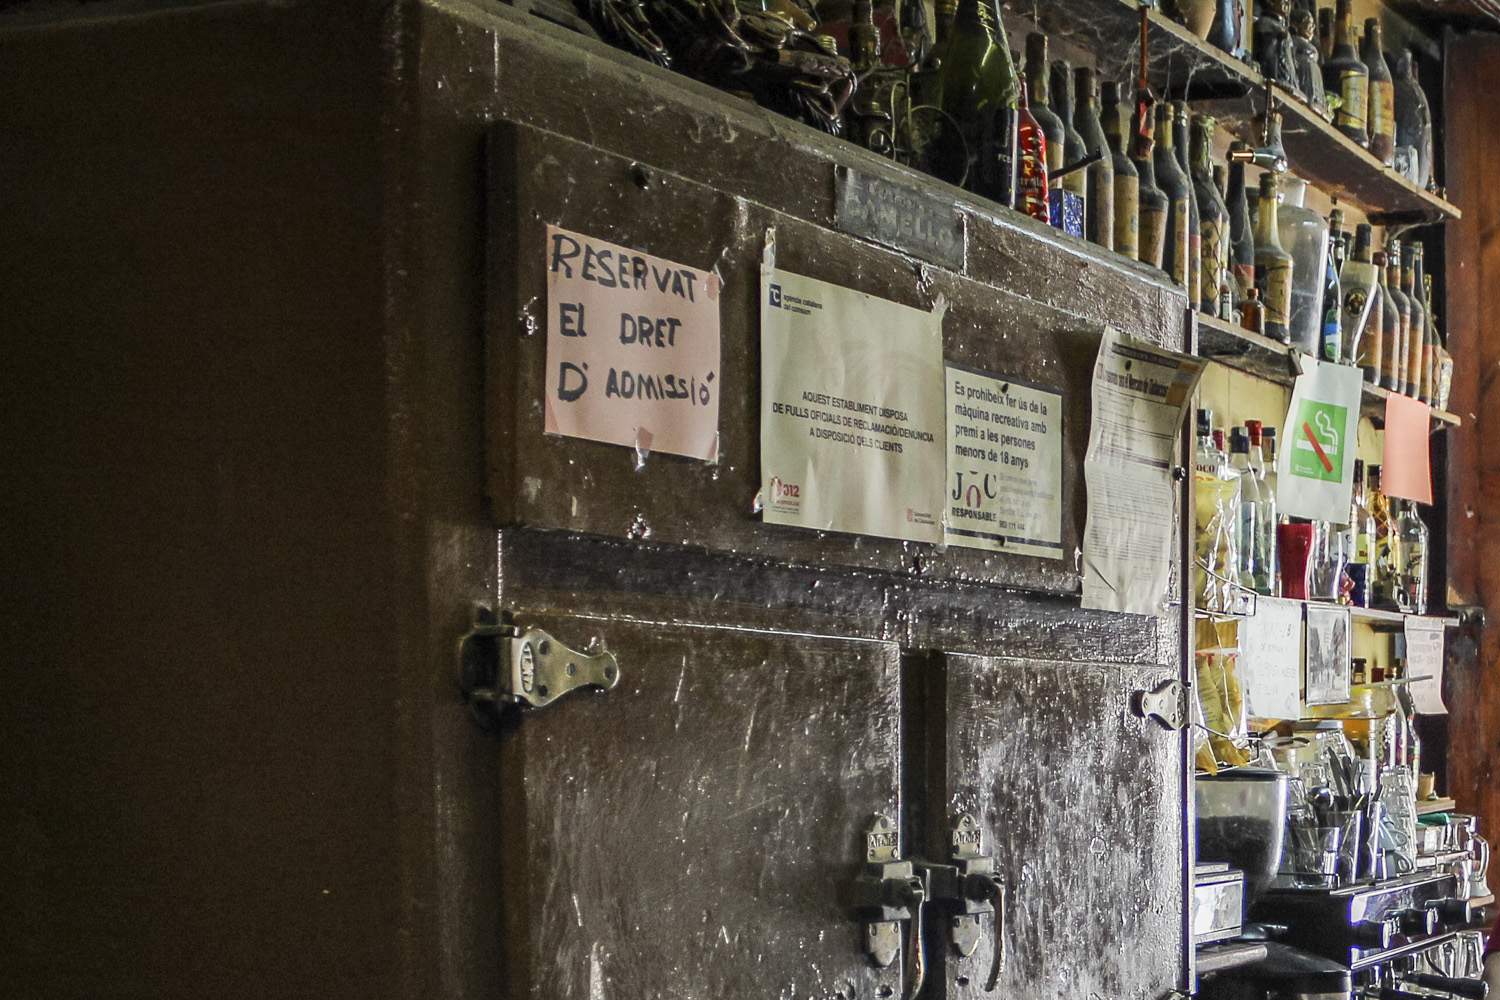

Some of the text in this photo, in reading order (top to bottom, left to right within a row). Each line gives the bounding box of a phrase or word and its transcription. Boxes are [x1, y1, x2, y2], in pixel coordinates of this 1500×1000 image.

[551, 234, 697, 303] RESERVAT
[619, 312, 682, 348] DRET
[802, 391, 908, 421] AQUEST ESTABLIMENT DISPOSA
[955, 381, 1048, 416] Es prohibeix fer ús de la
[772, 402, 783, 414] DE
[785, 404, 809, 419] FULLS
[810, 407, 841, 426] OFICIALS
[842, 415, 853, 427] DE
[955, 403, 1047, 434] màquina recreativa amb
[809, 427, 903, 453] A DISPOSICIÓ DELS CLIENTS
[955, 424, 1036, 451] premi a les persones
[955, 444, 1029, 470] menors de 18 anys
[952, 506, 997, 522] RESPONSABLE
